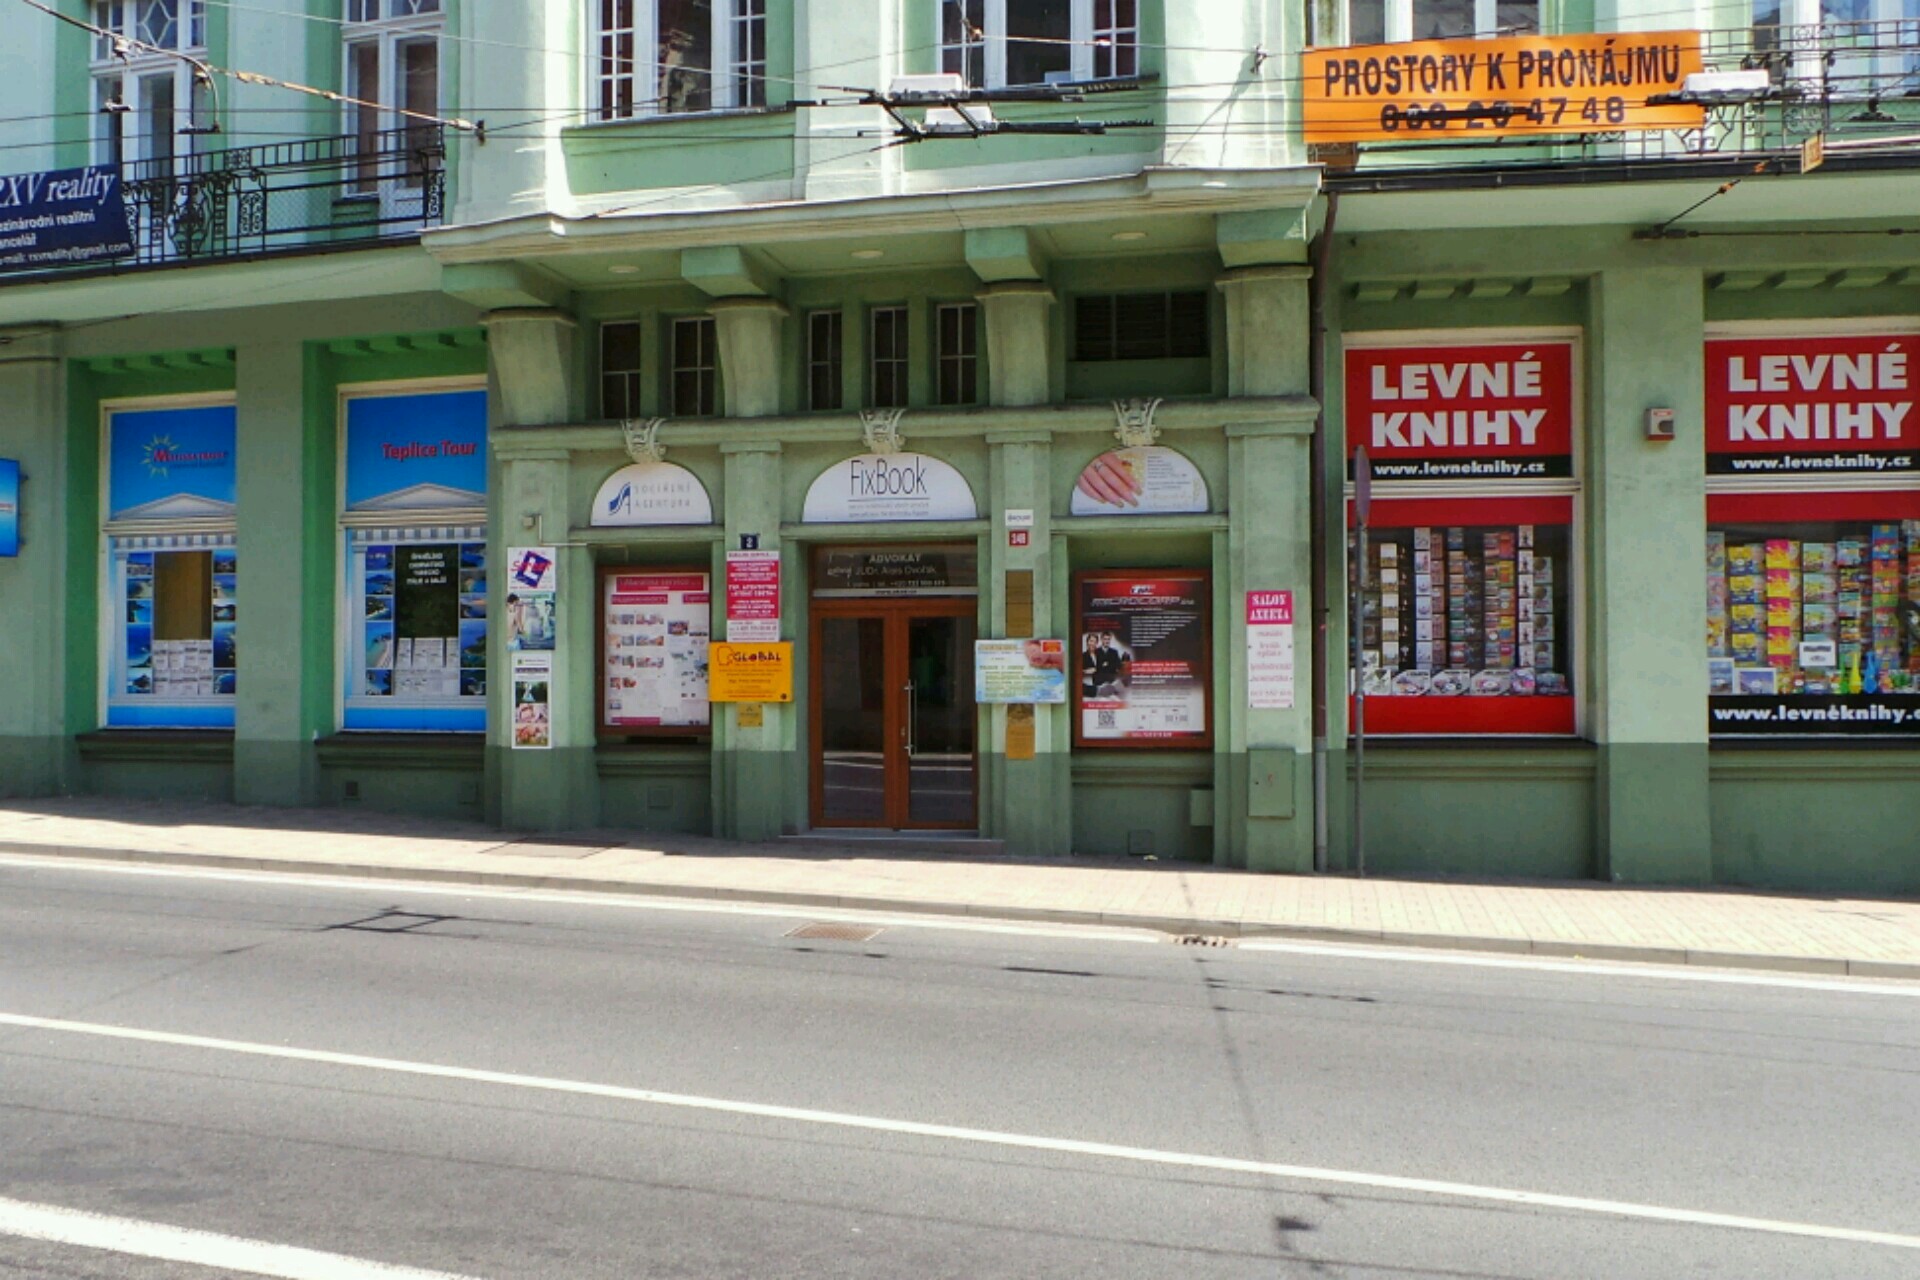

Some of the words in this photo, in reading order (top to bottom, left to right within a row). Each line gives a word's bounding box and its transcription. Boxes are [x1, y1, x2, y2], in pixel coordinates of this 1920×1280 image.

[1325, 53, 1476, 97] PROSTORY
[1487, 52, 1506, 91] K
[1518, 38, 1680, 89] PRONÁJMU
[1582, 96, 1624, 123] 48
[45, 166, 117, 206] reality
[1371, 351, 1542, 400] LEVNÉ
[1728, 343, 1908, 392] LEVNÉ
[1372, 409, 1547, 447] KNIHY
[1729, 402, 1913, 441] KNIHY
[381, 442, 438, 460] Teplice
[441, 440, 476, 455] Tour
[1374, 459, 1545, 476] www.levneknihy.cz
[1732, 453, 1911, 470] www.levneknihy.cz
[850, 455, 927, 496] FixBook
[745, 536, 753, 548] 2
[1252, 594, 1286, 606] SALON
